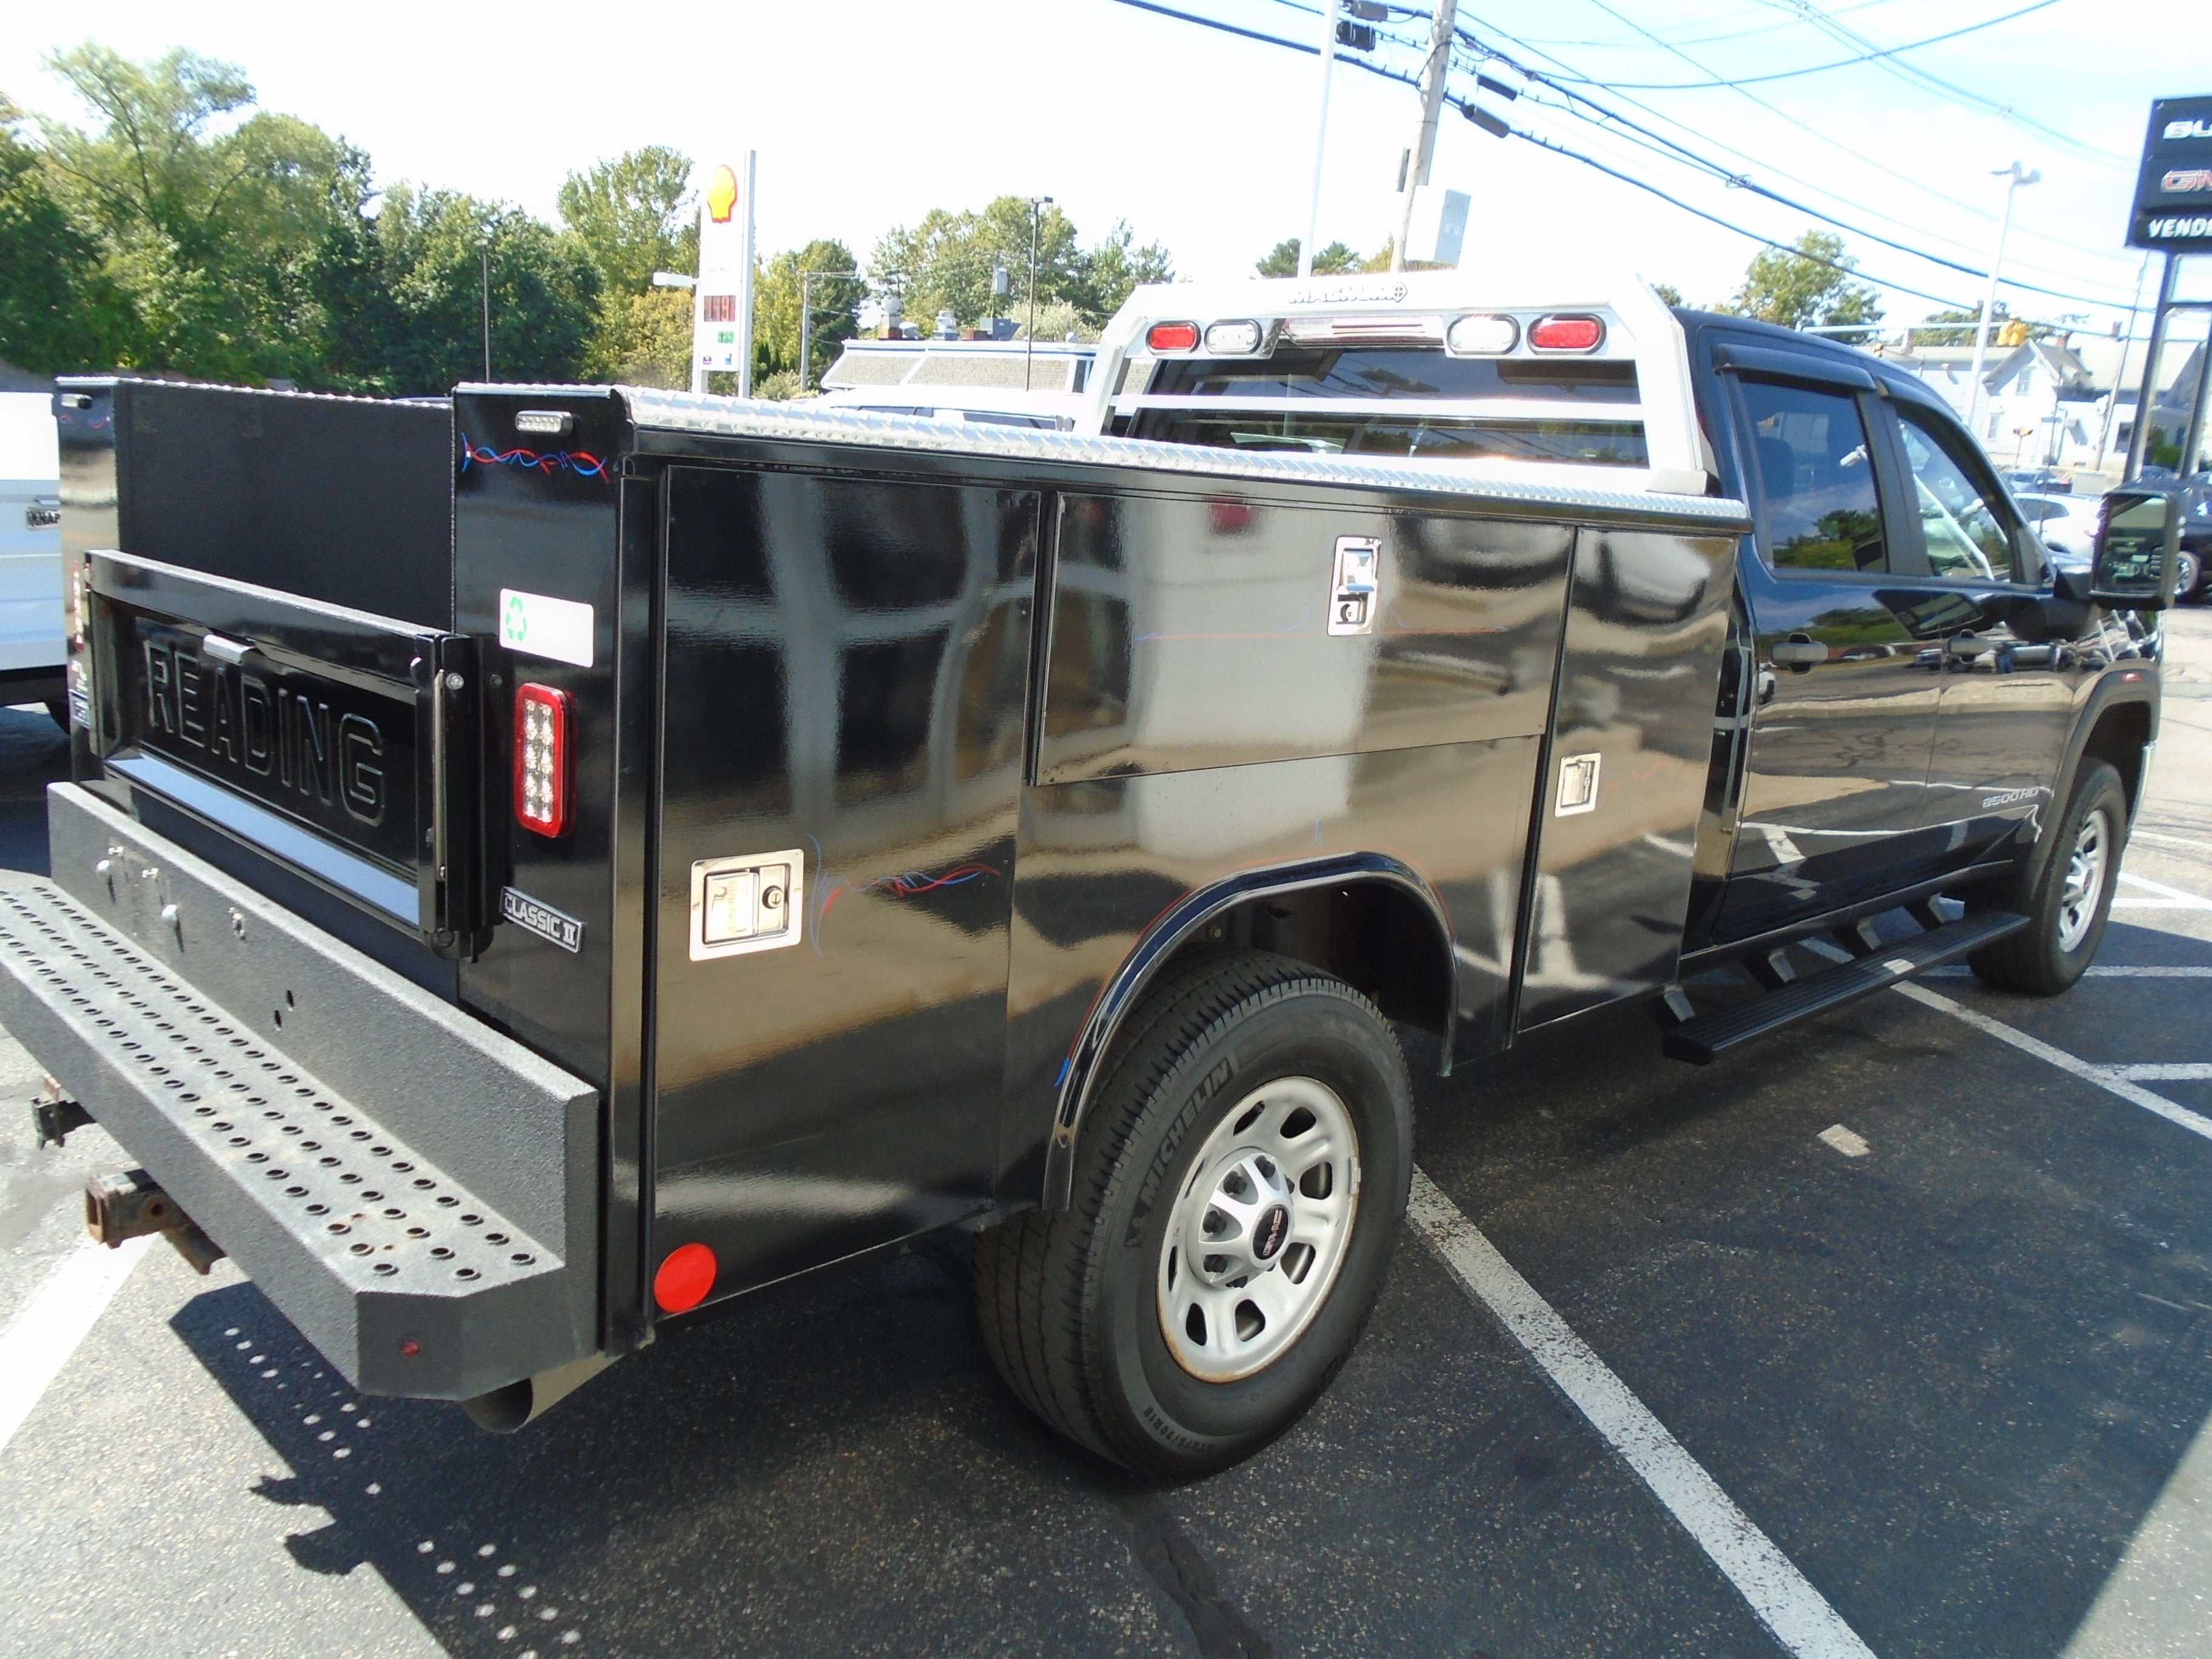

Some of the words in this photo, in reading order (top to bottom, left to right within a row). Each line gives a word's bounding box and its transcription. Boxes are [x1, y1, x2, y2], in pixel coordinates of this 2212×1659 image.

[1289, 285, 1395, 304] MAGNUM
[144, 640, 386, 828] READING
[504, 892, 561, 939] CLASSIC
[562, 922, 577, 946] II
[1139, 1056, 1233, 1209] MICHELIN
[1262, 1209, 1283, 1256] GMC
